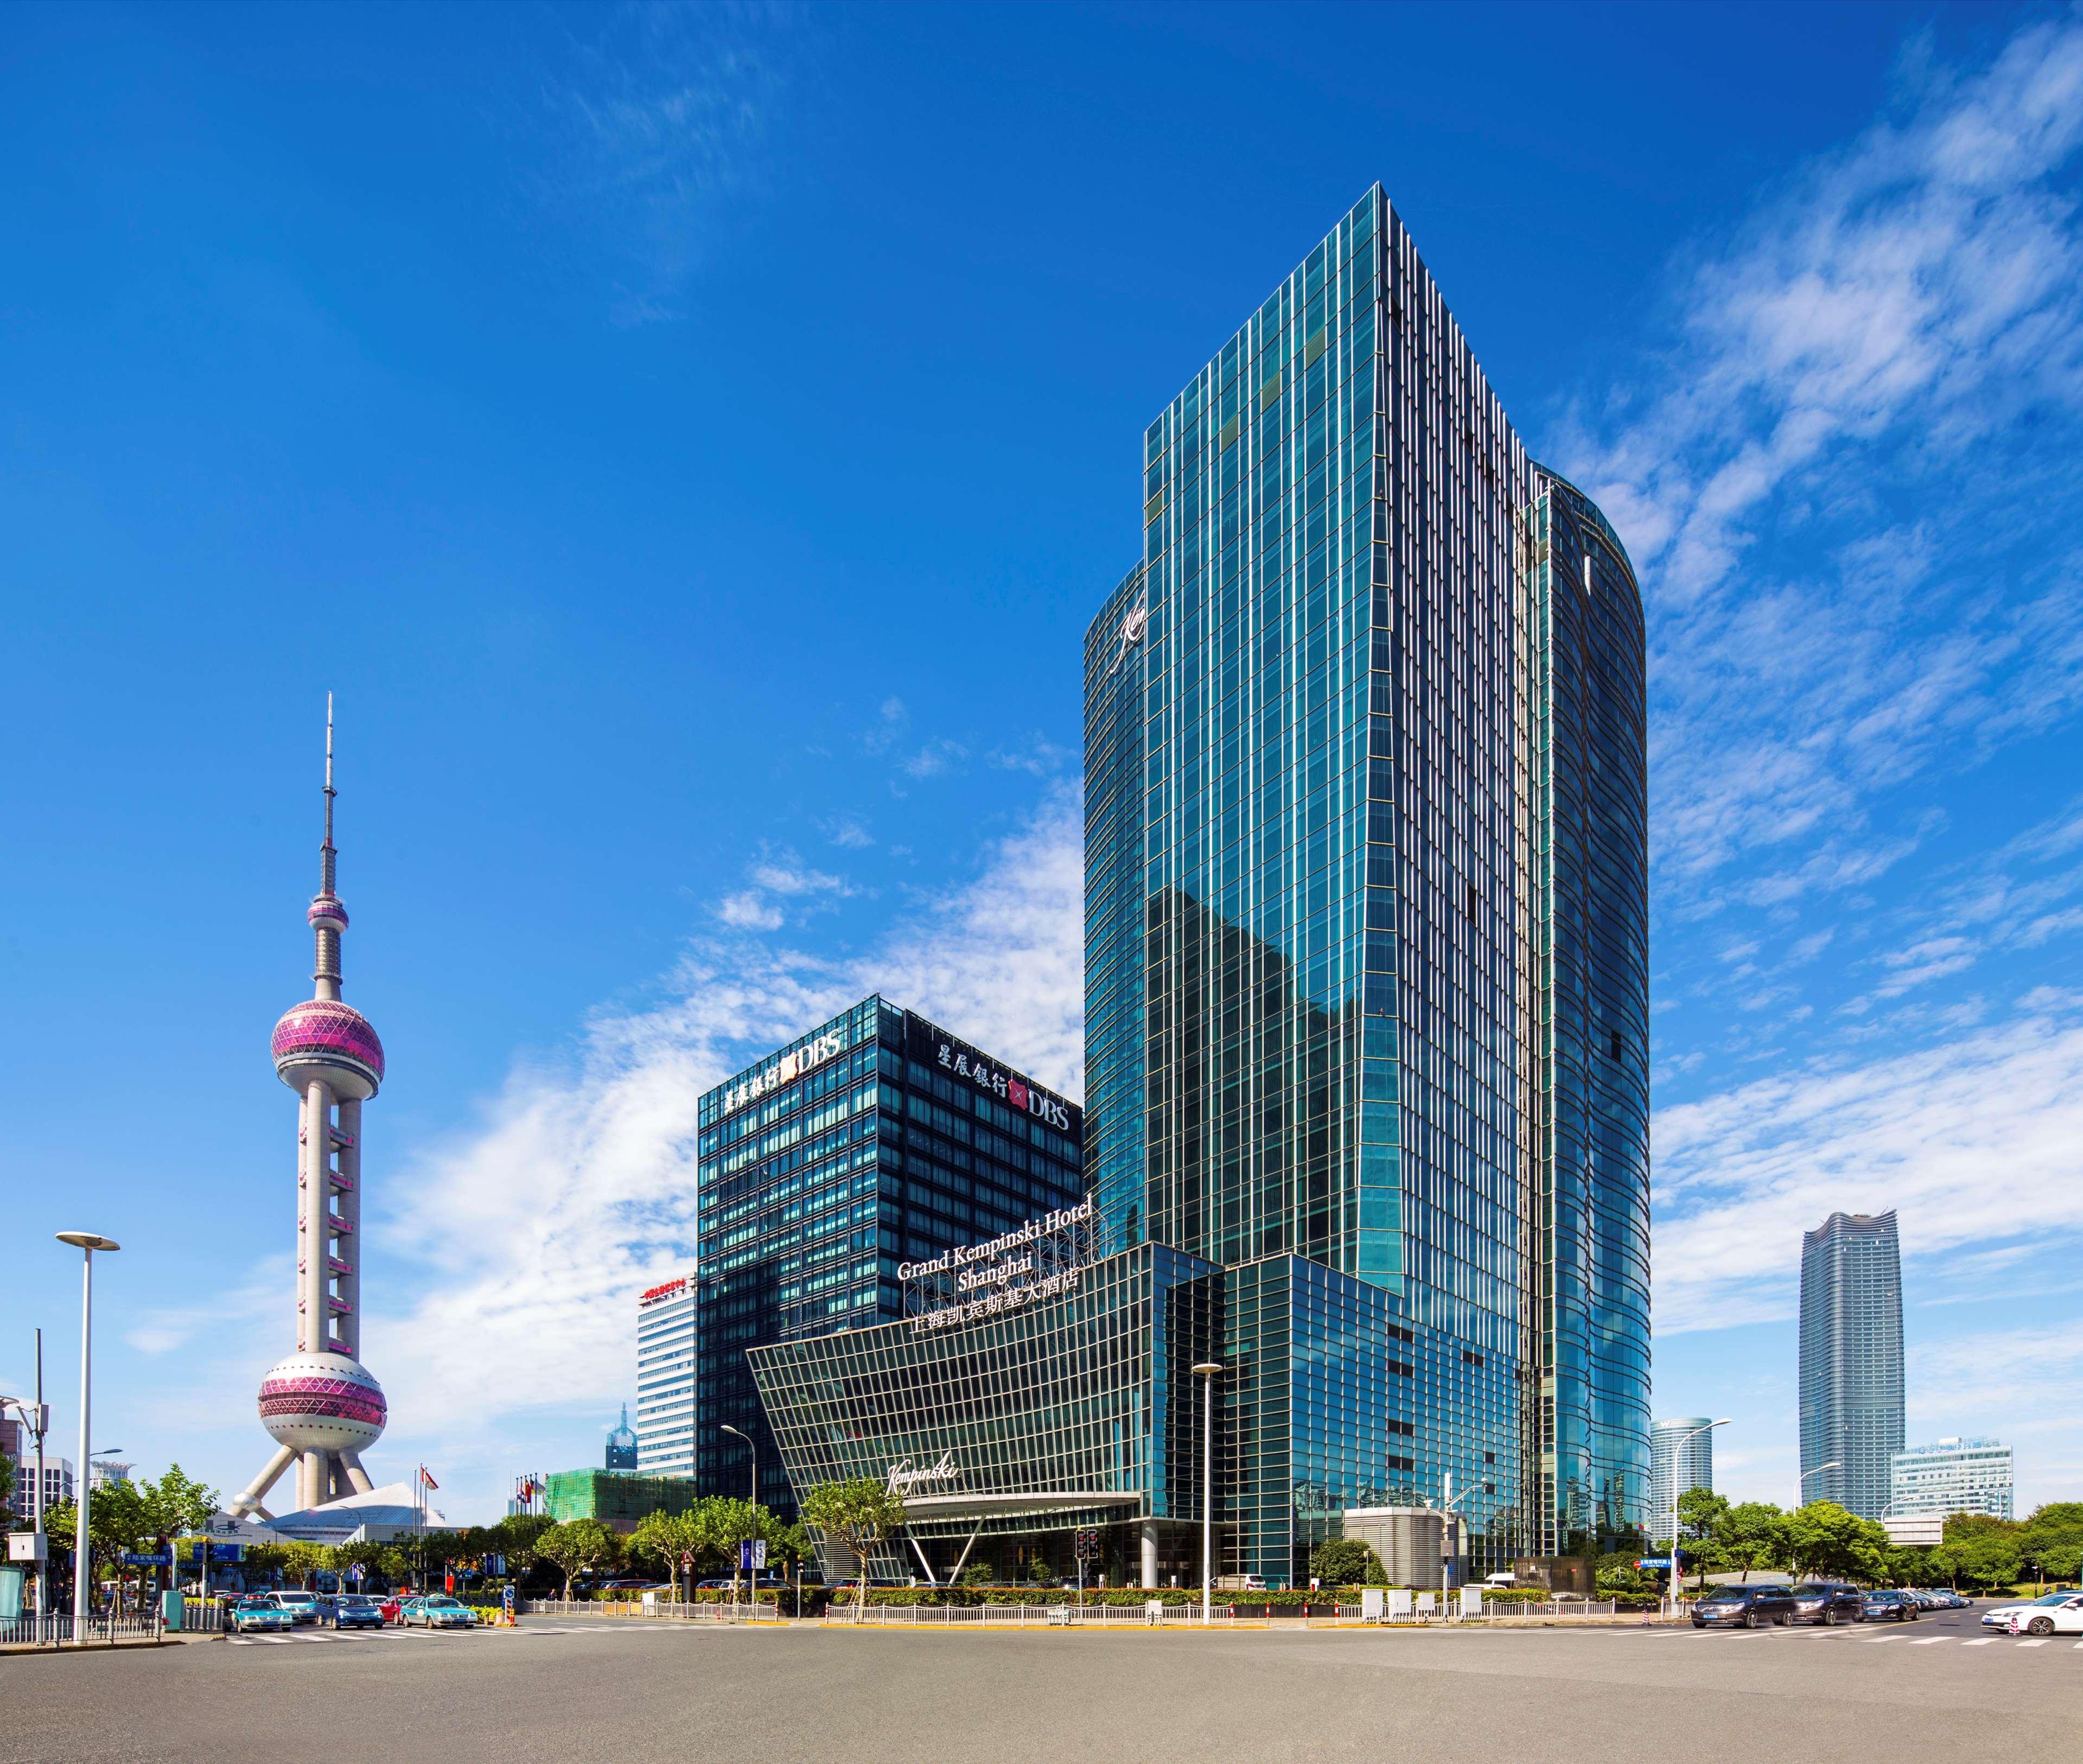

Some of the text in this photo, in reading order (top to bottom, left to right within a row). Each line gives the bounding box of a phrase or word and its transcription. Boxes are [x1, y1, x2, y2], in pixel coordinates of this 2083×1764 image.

[798, 1029, 840, 1074] DBS
[1028, 1088, 1069, 1130] DBS
[897, 1192, 1094, 1281] Grand Kempinski Hotel
[958, 1251, 1032, 1292] Shanghai
[914, 1267, 1081, 1332] 上海凯宾斯基大酒店
[884, 1450, 960, 1498] Kempinski
